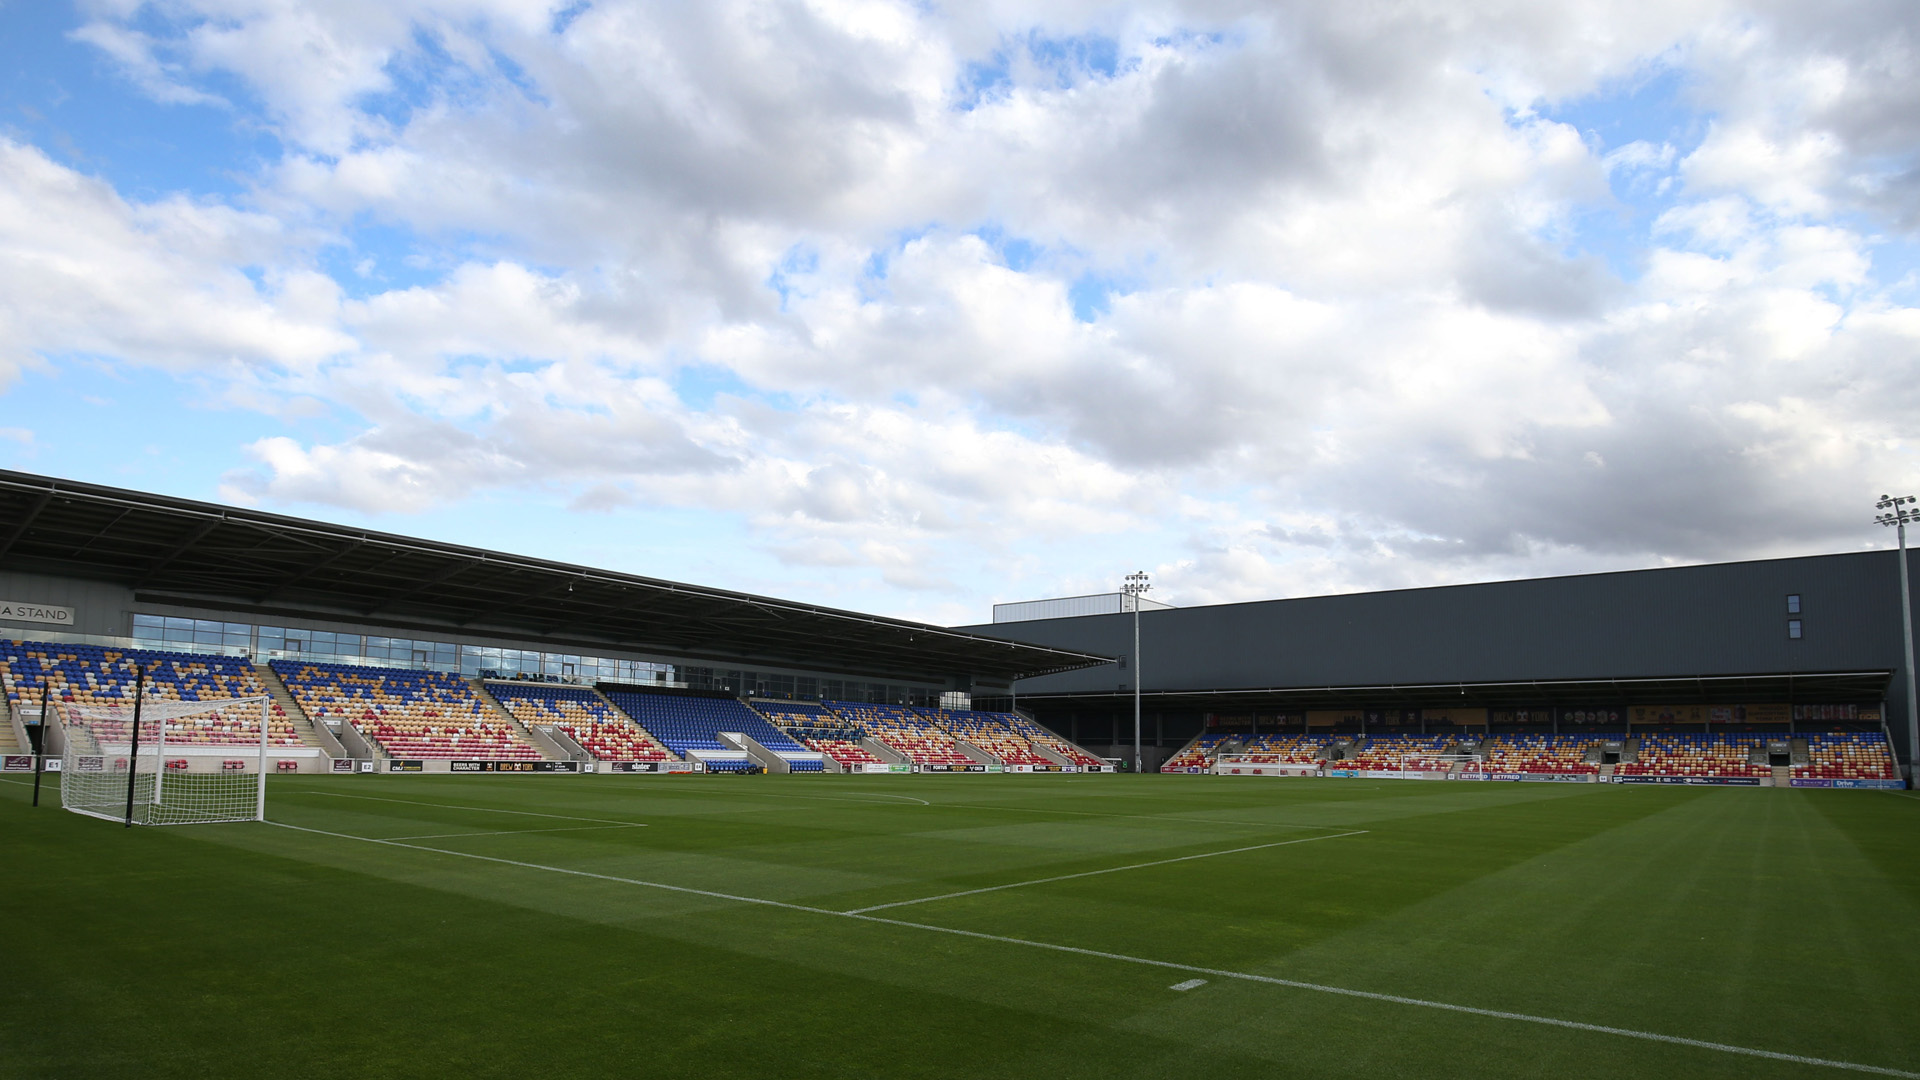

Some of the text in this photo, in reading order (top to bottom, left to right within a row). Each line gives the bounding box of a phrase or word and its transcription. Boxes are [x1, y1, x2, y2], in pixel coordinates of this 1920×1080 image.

[16, 607, 68, 620] STAND
[499, 763, 534, 771] BREW YORK
